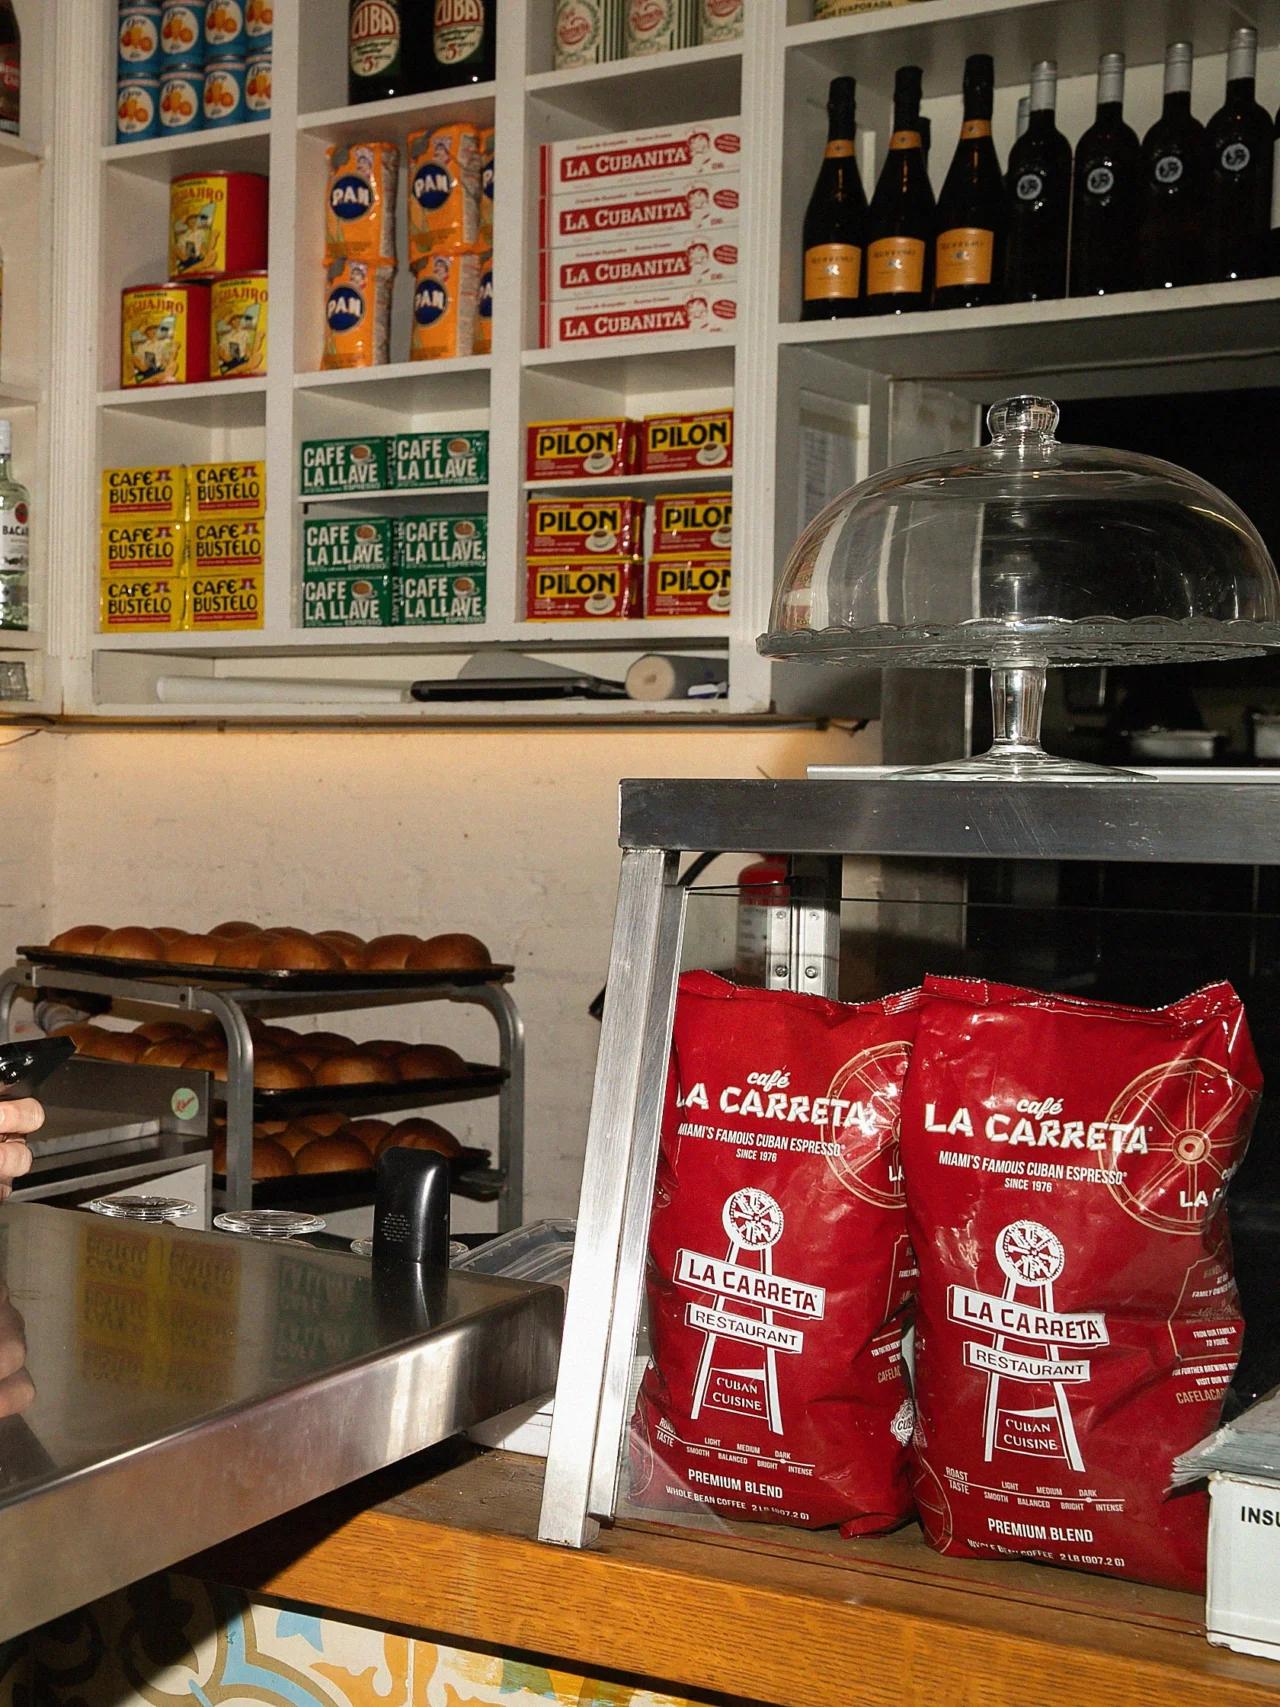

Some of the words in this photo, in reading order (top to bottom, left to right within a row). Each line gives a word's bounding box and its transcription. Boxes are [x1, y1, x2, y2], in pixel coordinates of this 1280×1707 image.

[565, 161, 590, 178] LA
[596, 146, 687, 173] CUBANITA
[565, 214, 589, 231] LA
[595, 202, 686, 227] CUBANITA
[565, 268, 589, 285] LA
[595, 257, 686, 281] CUBANITA
[565, 321, 589, 338] LA
[595, 310, 686, 334] CUBANITA
[539, 431, 614, 456] PILON
[651, 422, 727, 449] PILON
[304, 446, 346, 467] CAFE
[397, 439, 442, 460] CAFE
[109, 471, 153, 487] CAFE
[196, 466, 240, 484] CAFE
[304, 467, 326, 487] LA
[329, 463, 378, 486] LLAVE
[397, 460, 420, 480] LA
[424, 457, 477, 479] LLAVE
[109, 485, 173, 504] BUSTELO
[197, 481, 260, 501] BUSTELO
[196, 523, 239, 540] CAFE
[406, 521, 448, 542] CAFE
[539, 509, 617, 532] PILON
[108, 528, 153, 544] CAFE
[307, 526, 350, 546] CAFE
[108, 542, 174, 560] BUSTELO
[196, 538, 261, 557] BUSTELO
[307, 546, 329, 566] LA
[332, 544, 384, 565] LLAVE
[406, 542, 428, 563] LA
[432, 541, 482, 561] LLAVE
[108, 582, 151, 598] CAFE
[193, 579, 237, 596] CAFE
[305, 581, 347, 601] CAFE
[405, 577, 448, 598] CAFE
[539, 573, 616, 595] PILON
[108, 597, 172, 615] BUSTELO
[193, 594, 258, 613] BUSTELO
[305, 601, 327, 620] LA
[330, 600, 380, 620] LLAVE
[405, 598, 427, 618] LA
[431, 597, 481, 617] LLAVE
[747, 1069, 791, 1092] café
[719, 1086, 866, 1128] CARRETA
[1016, 1097, 1064, 1121] café
[678, 1122, 714, 1140] MIAMI'S
[715, 1127, 756, 1146] FAMOUS
[756, 1133, 789, 1150] CUBAN
[790, 1137, 841, 1157] ESPRESSO
[925, 1103, 974, 1137] LA
[985, 1113, 1148, 1155] CARRETA
[736, 1148, 757, 1160] SINCE
[759, 1150, 777, 1162] 1976
[938, 1150, 980, 1170] MIAMI'S
[982, 1157, 1025, 1176] FAMOUS
[1026, 1161, 1063, 1179] CUBAN
[1066, 1166, 1123, 1185] ESPRESSO
[1004, 1177, 1029, 1190] SINCE
[1032, 1180, 1053, 1192] 1976
[1180, 1190, 1209, 1208] LA
[688, 1258, 716, 1285] LA
[722, 1271, 816, 1312] CARRETA
[695, 1310, 798, 1347] RESTAURANT
[963, 1295, 993, 1323] LA
[1001, 1308, 1100, 1341] CARRETA
[976, 1349, 1084, 1376] RESTAURANT
[716, 1377, 758, 1394] CUBAN
[712, 1392, 762, 1412] CUISINE
[1005, 1418, 1051, 1433] CUBAN
[656, 1431, 675, 1447] TASTE
[686, 1446, 710, 1457] SMOOTH
[718, 1452, 748, 1465] BALANCED
[757, 1460, 778, 1470] BRIGHT
[788, 1466, 813, 1476] INTENSE
[704, 1437, 721, 1447] LIGHT
[736, 1443, 761, 1454] MEDIUM
[775, 1450, 791, 1459] DARK
[1003, 1434, 1058, 1451] CUISINE
[688, 1468, 742, 1491] PREMIUM
[745, 1481, 783, 1499] BLEND
[946, 1466, 968, 1481] ROAST
[1001, 1481, 1019, 1491] LIGHT
[1036, 1486, 1062, 1496] MEDIUM
[1078, 1489, 1097, 1497] DARK
[665, 1485, 692, 1500] WHOLE
[693, 1493, 716, 1504] BEAN
[716, 1497, 747, 1510] COFFEE
[949, 1480, 970, 1495] TASTE
[984, 1491, 1009, 1503] SMOOTH
[1017, 1497, 1051, 1509] BALANCED
[1060, 1502, 1084, 1511] BRIGHT
[1095, 1503, 1124, 1512] INTENSE
[987, 1518, 1047, 1540] PREMIUM
[1050, 1528, 1094, 1543] BLEND
[1060, 1553, 1067, 1561] 2
[1081, 1555, 1112, 1566] (907.2
